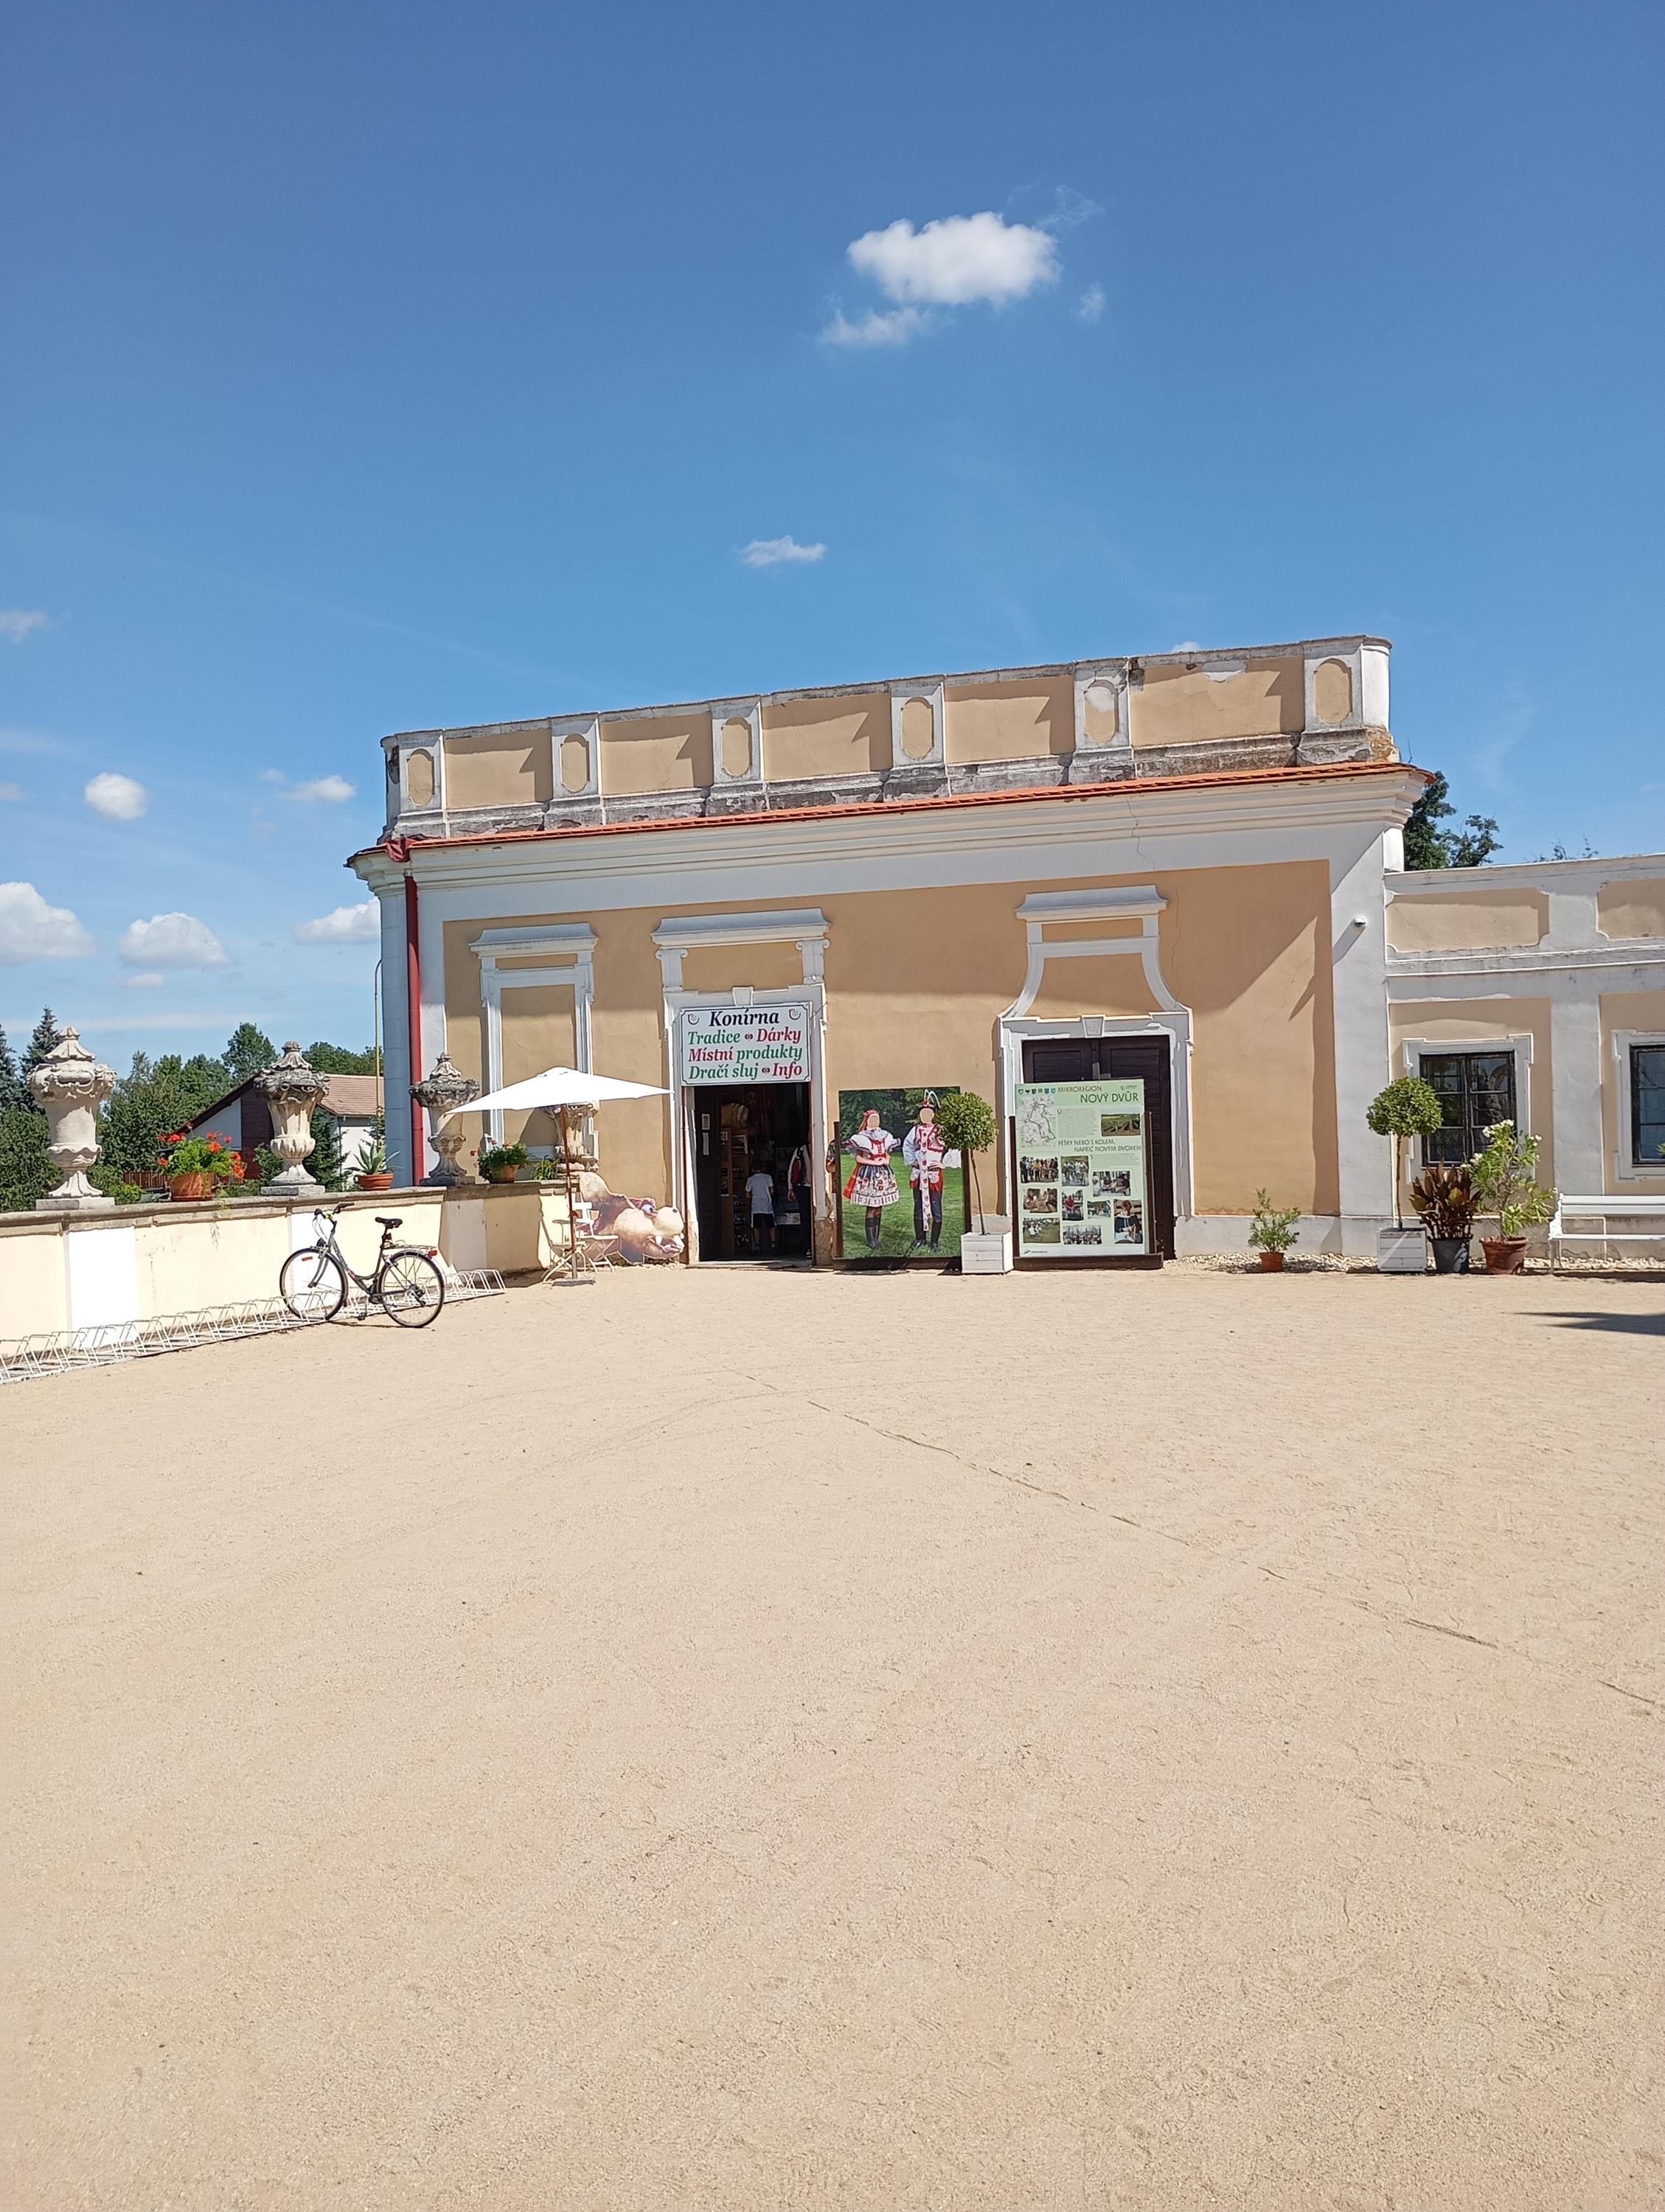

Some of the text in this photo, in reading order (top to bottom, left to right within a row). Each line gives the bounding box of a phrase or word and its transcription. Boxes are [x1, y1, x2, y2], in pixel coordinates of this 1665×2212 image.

[709, 1009, 779, 1026] Konírna
[688, 1027, 802, 1045] Tradice Dárky
[688, 1045, 802, 1063] Místní produkty
[689, 1062, 802, 1080] Dračí sluj Info
[1080, 1091, 1139, 1103] NOVÝ DVŮR
